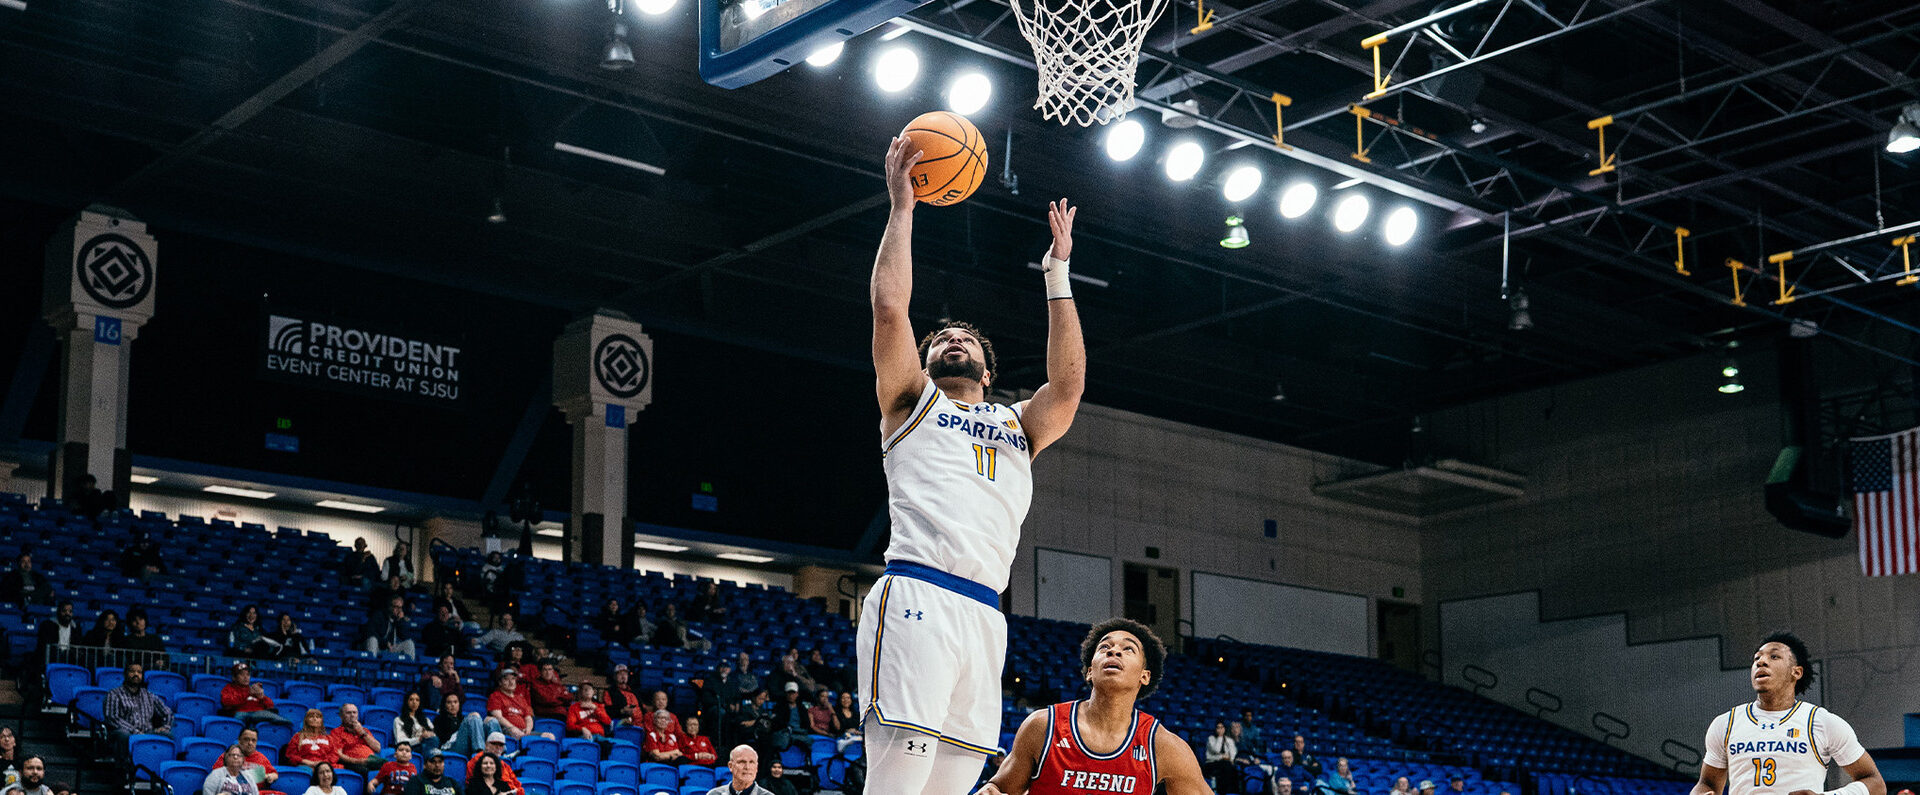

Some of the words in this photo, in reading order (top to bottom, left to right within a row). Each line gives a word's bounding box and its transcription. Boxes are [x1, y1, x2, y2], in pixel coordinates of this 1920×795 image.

[98, 322, 119, 339] 16
[310, 322, 460, 366] PROVIDENT
[268, 355, 322, 377] EVENT
[327, 365, 391, 388] CENTER
[395, 378, 418, 391] AT
[419, 382, 459, 399] SJSU
[308, 345, 383, 369] CREDIT
[393, 361, 460, 382] UNION
[936, 412, 1027, 452] SPARTANS
[971, 443, 998, 482] 11
[1729, 741, 1808, 755] SPARTANS
[1060, 769, 1137, 794] FRESNO
[1751, 757, 1778, 787] 13
